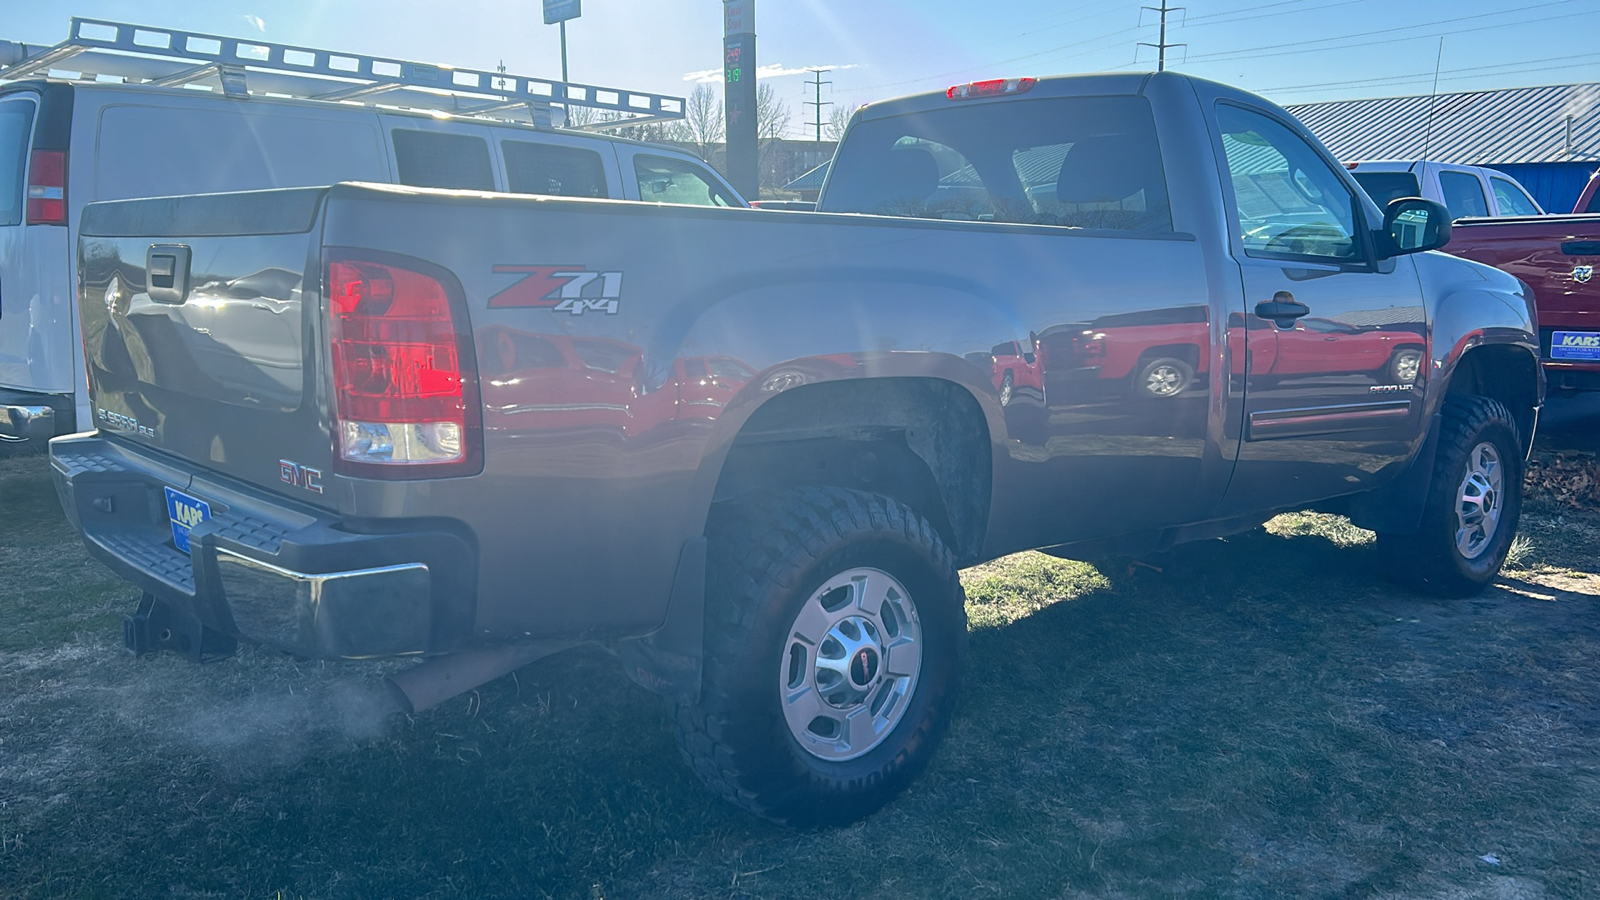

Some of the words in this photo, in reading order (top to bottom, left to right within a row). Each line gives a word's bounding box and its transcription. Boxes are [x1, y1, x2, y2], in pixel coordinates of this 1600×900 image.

[487, 264, 623, 309] Z71
[1562, 336, 1599, 347] KARS
[98, 408, 139, 433] SIERRA
[138, 425, 155, 439] SLE
[279, 459, 323, 495] GMC
[175, 500, 206, 527] KARS
